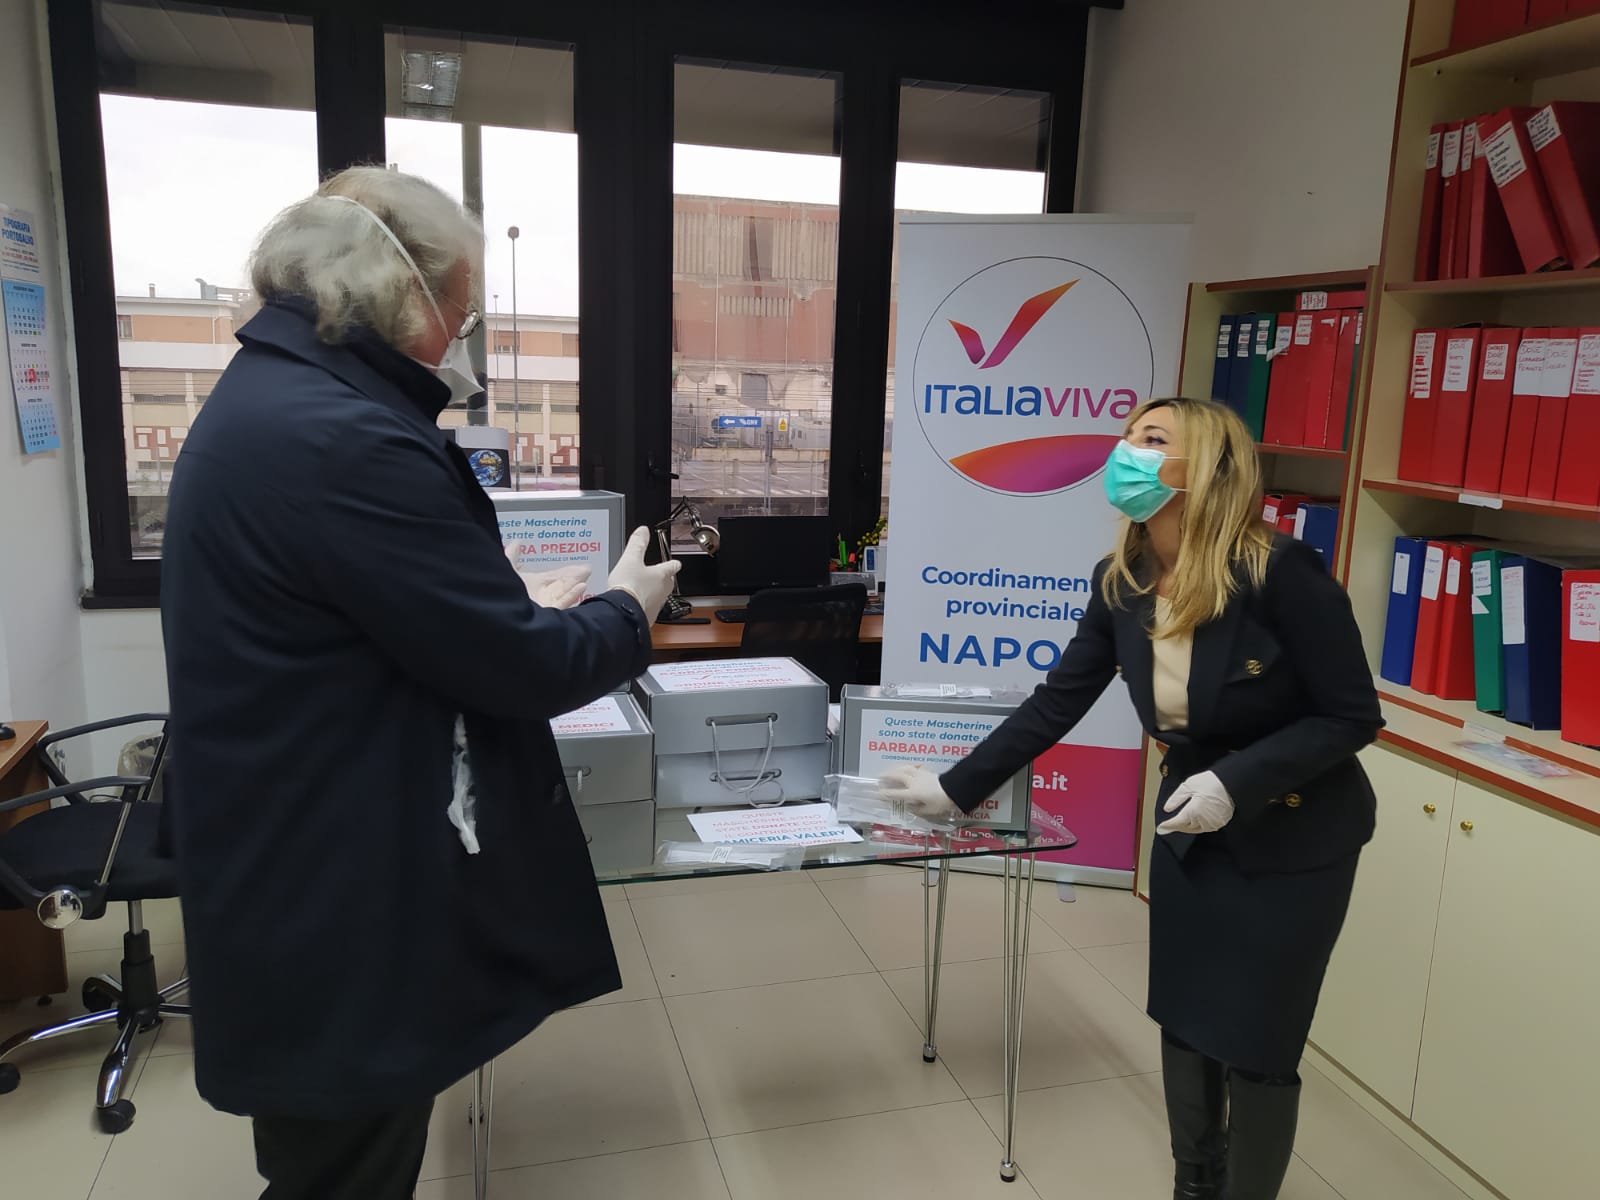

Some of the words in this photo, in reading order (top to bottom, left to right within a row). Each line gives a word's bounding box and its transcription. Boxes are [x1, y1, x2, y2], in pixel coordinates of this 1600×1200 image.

[498, 519, 521, 528] este
[525, 517, 587, 528] Mascherine
[506, 531, 535, 540] state
[538, 529, 576, 539] donate
[579, 529, 592, 538] da
[541, 542, 600, 555] PREZIOSI
[921, 566, 1089, 593] Coordinamen
[946, 597, 1086, 621] provinciale
[919, 632, 1062, 671] NAPO
[885, 716, 923, 728] Queste
[927, 719, 993, 731] Mascherine
[879, 729, 905, 738] sono
[908, 730, 936, 740] state
[940, 731, 980, 742] donate
[868, 740, 937, 755] BARBARA
[1032, 771, 1068, 792] a.it
[751, 821, 800, 831] DONATE
[793, 829, 846, 840] VALERY
